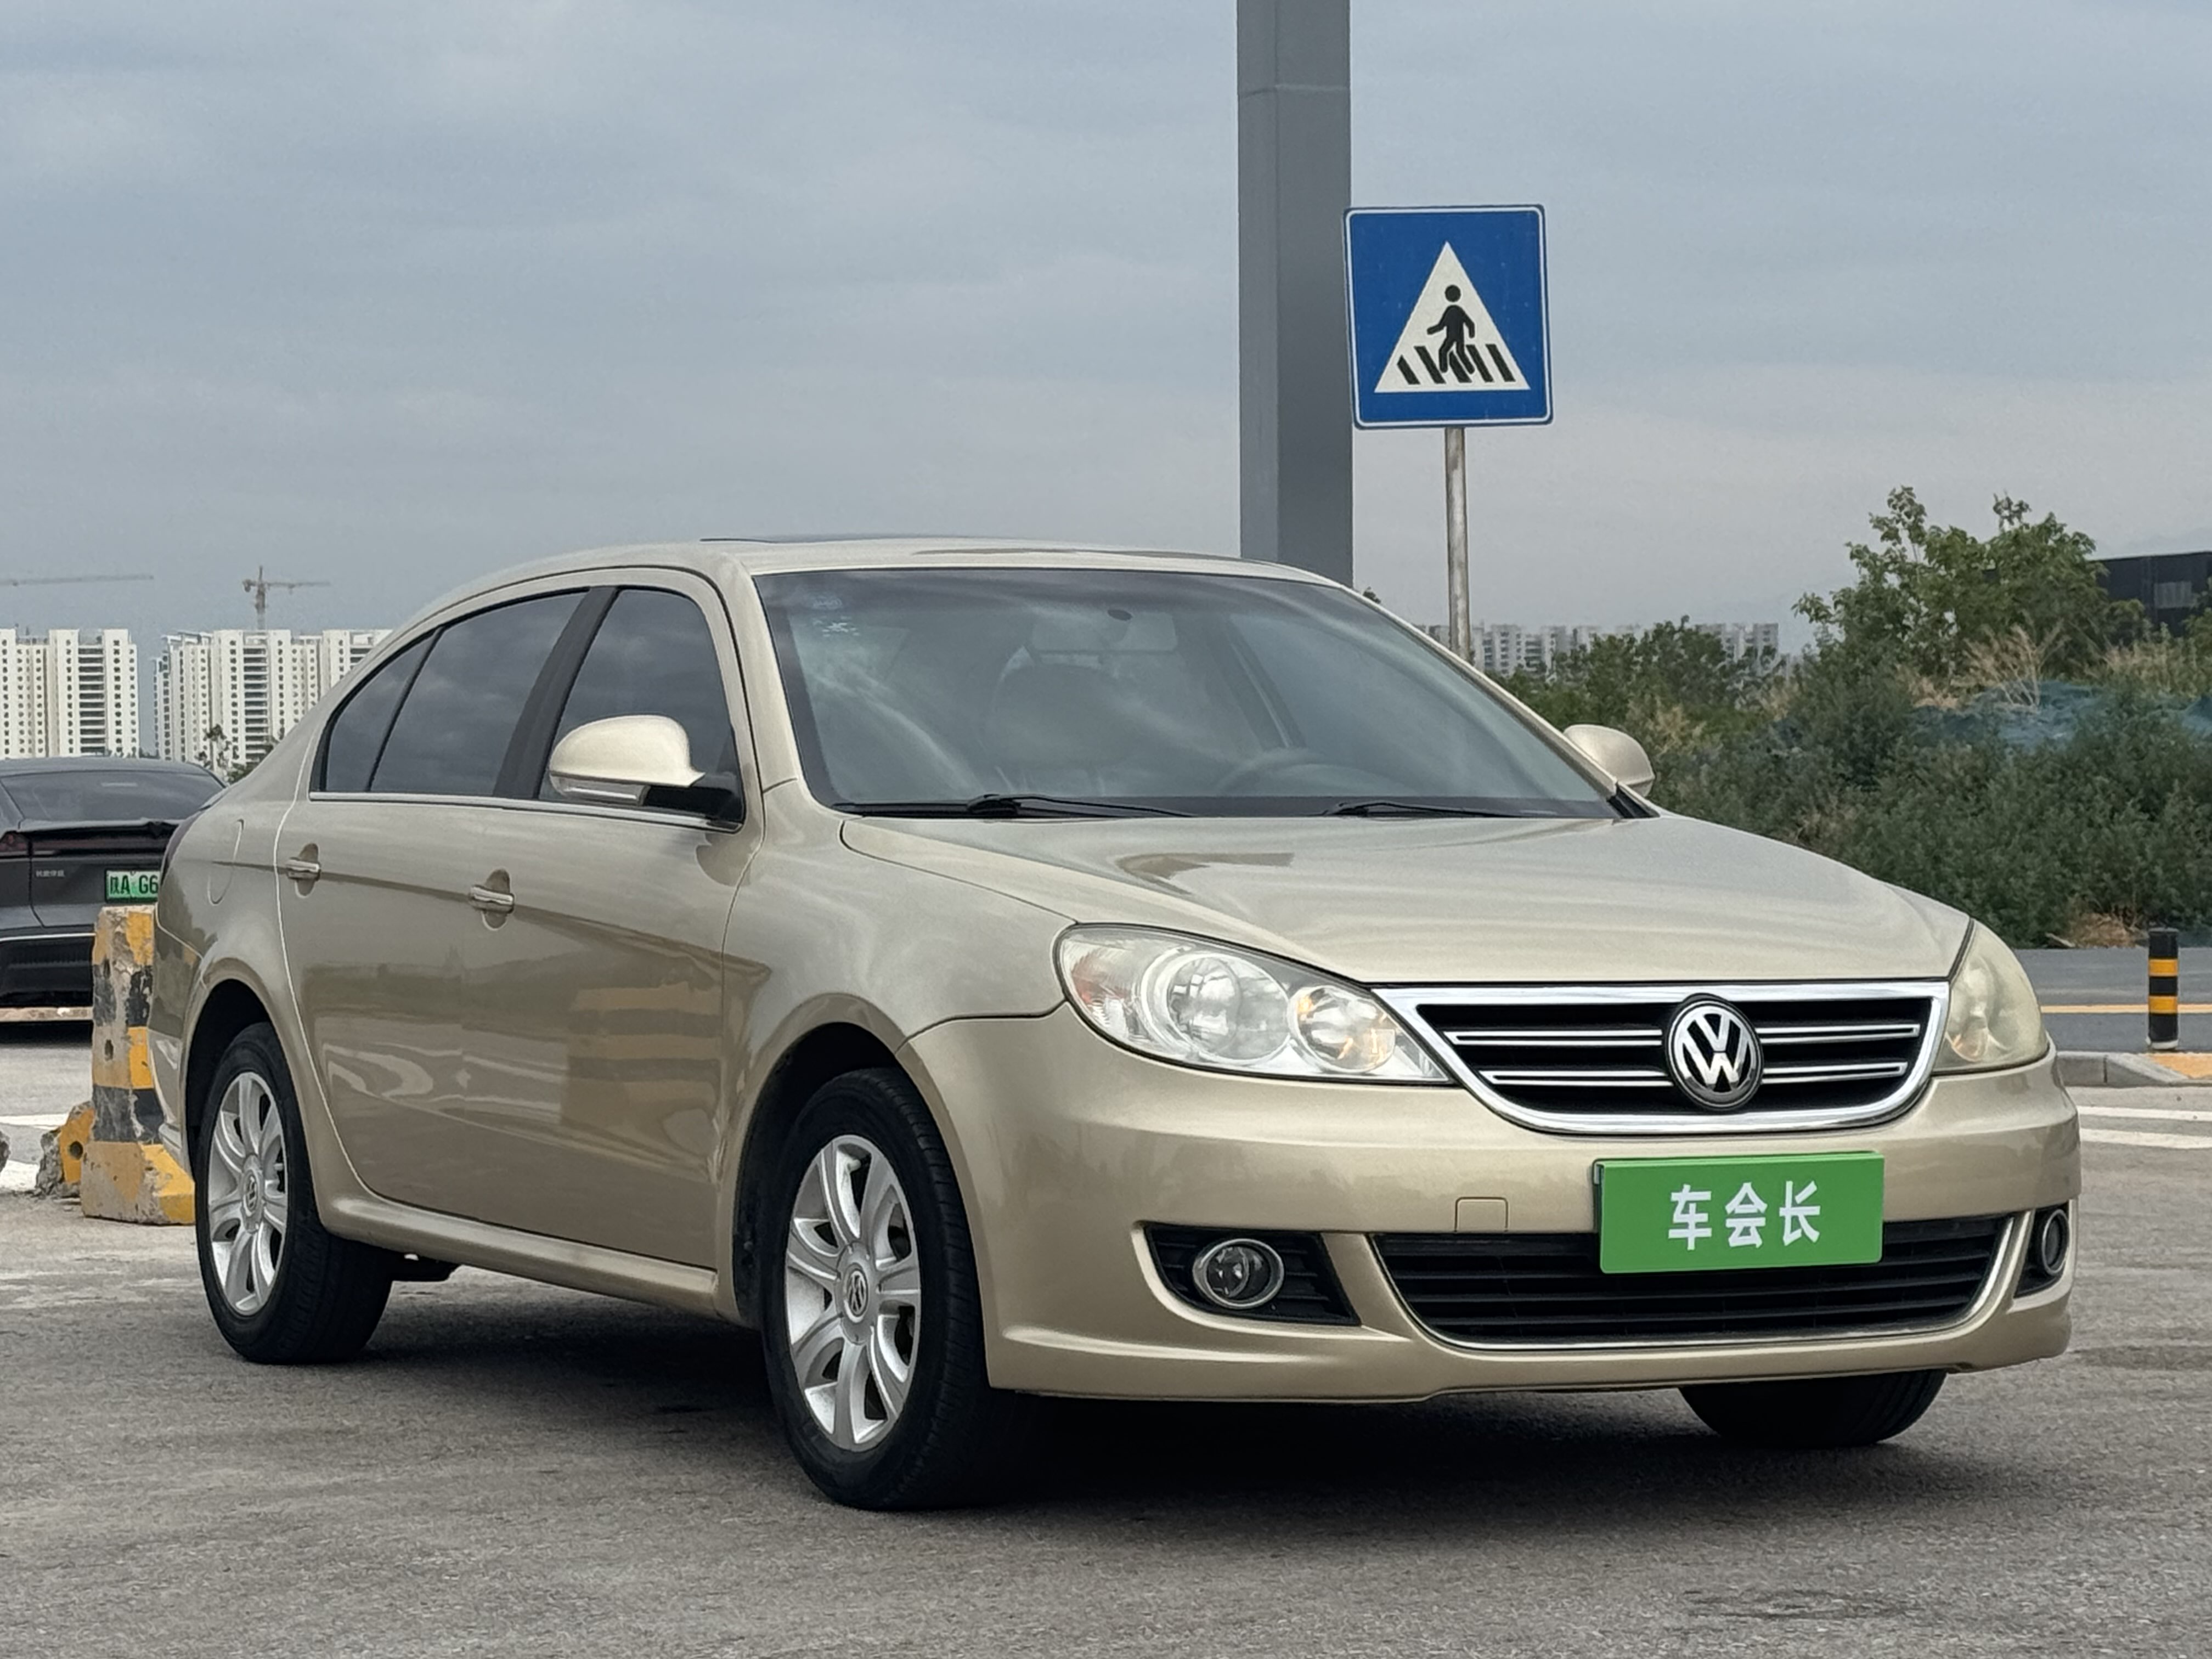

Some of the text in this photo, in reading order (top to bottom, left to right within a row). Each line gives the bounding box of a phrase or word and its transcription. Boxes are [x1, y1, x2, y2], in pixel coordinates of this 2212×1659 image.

[1674, 1005, 1756, 1102] VW
[1668, 1181, 1821, 1250] 车会长
